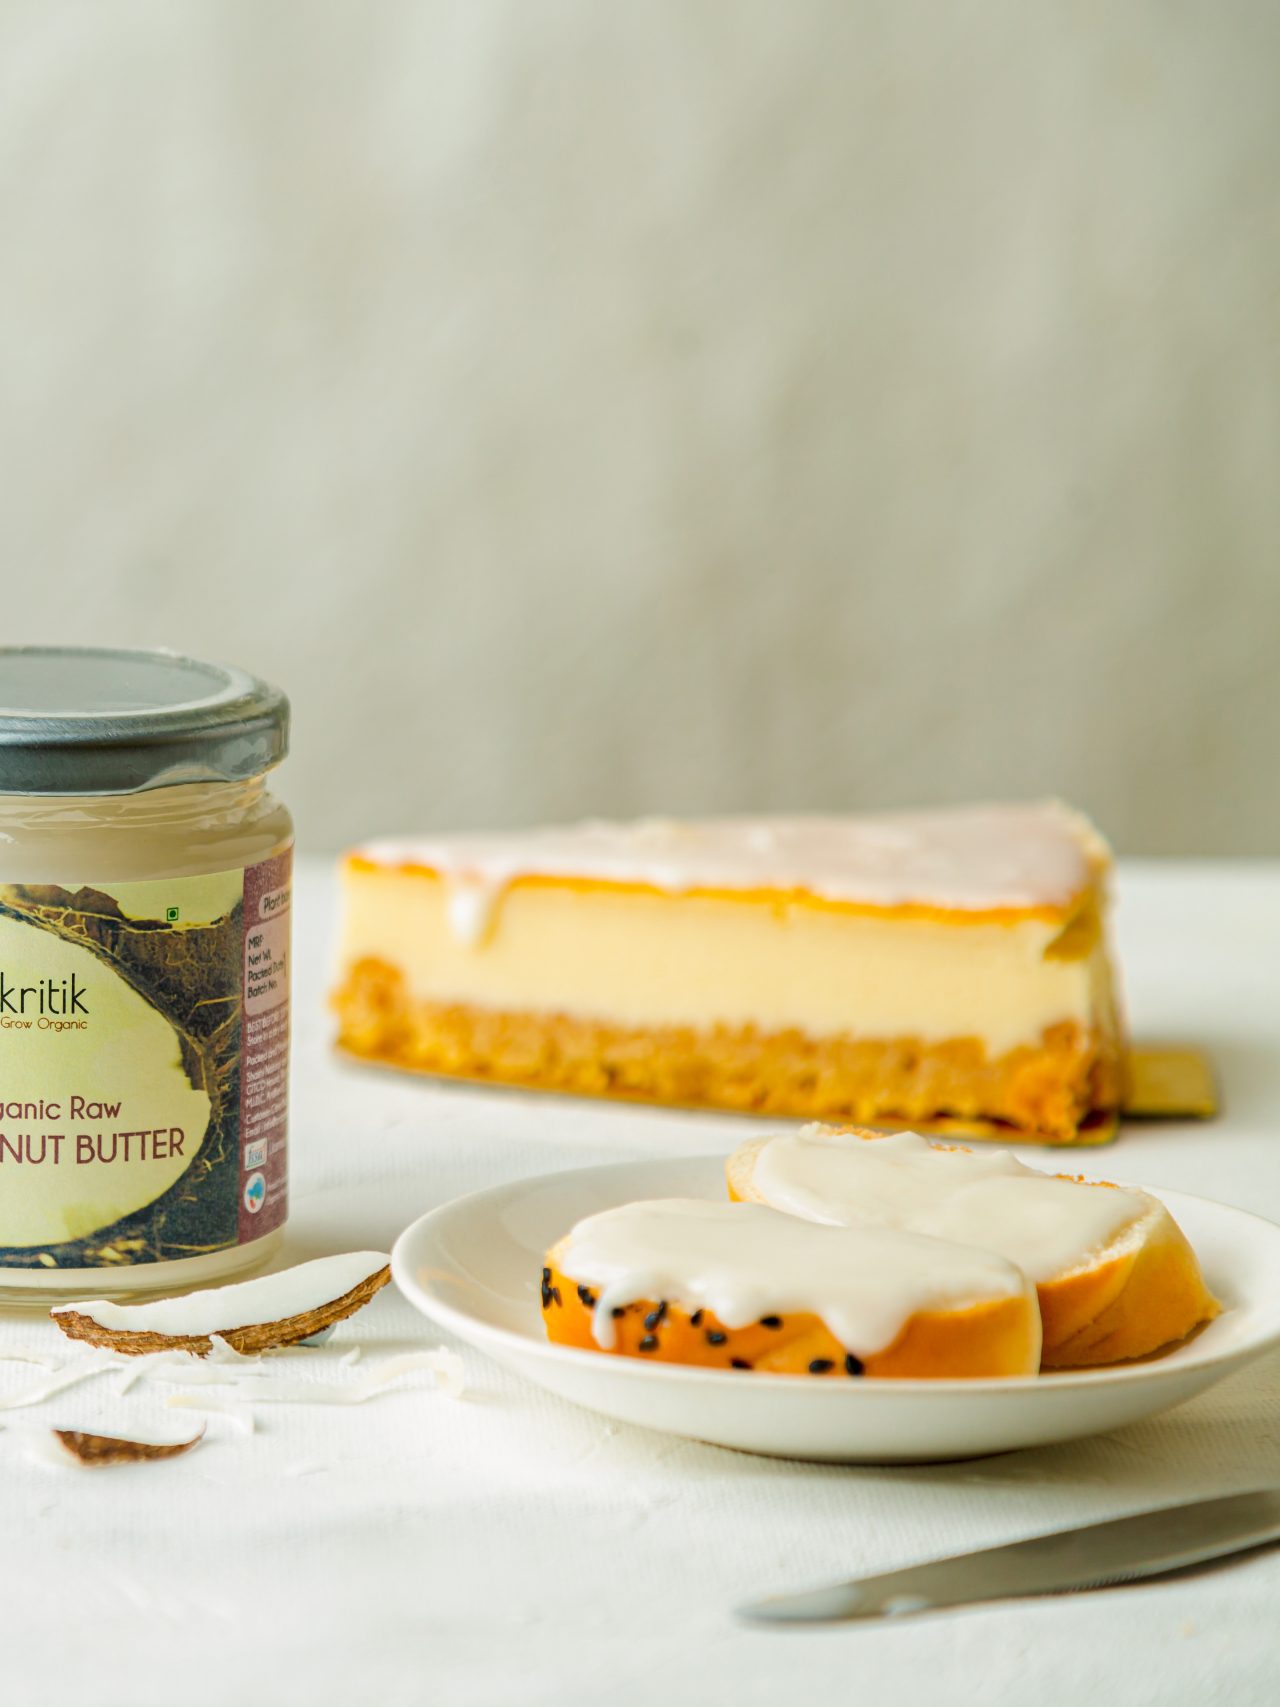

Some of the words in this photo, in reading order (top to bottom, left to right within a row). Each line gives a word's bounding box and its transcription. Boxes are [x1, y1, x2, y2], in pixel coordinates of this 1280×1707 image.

[0, 1016, 33, 1030] Grow
[37, 1017, 89, 1033] Organic
[71, 1095, 122, 1119] Raw
[76, 1127, 185, 1164] BUTTER
